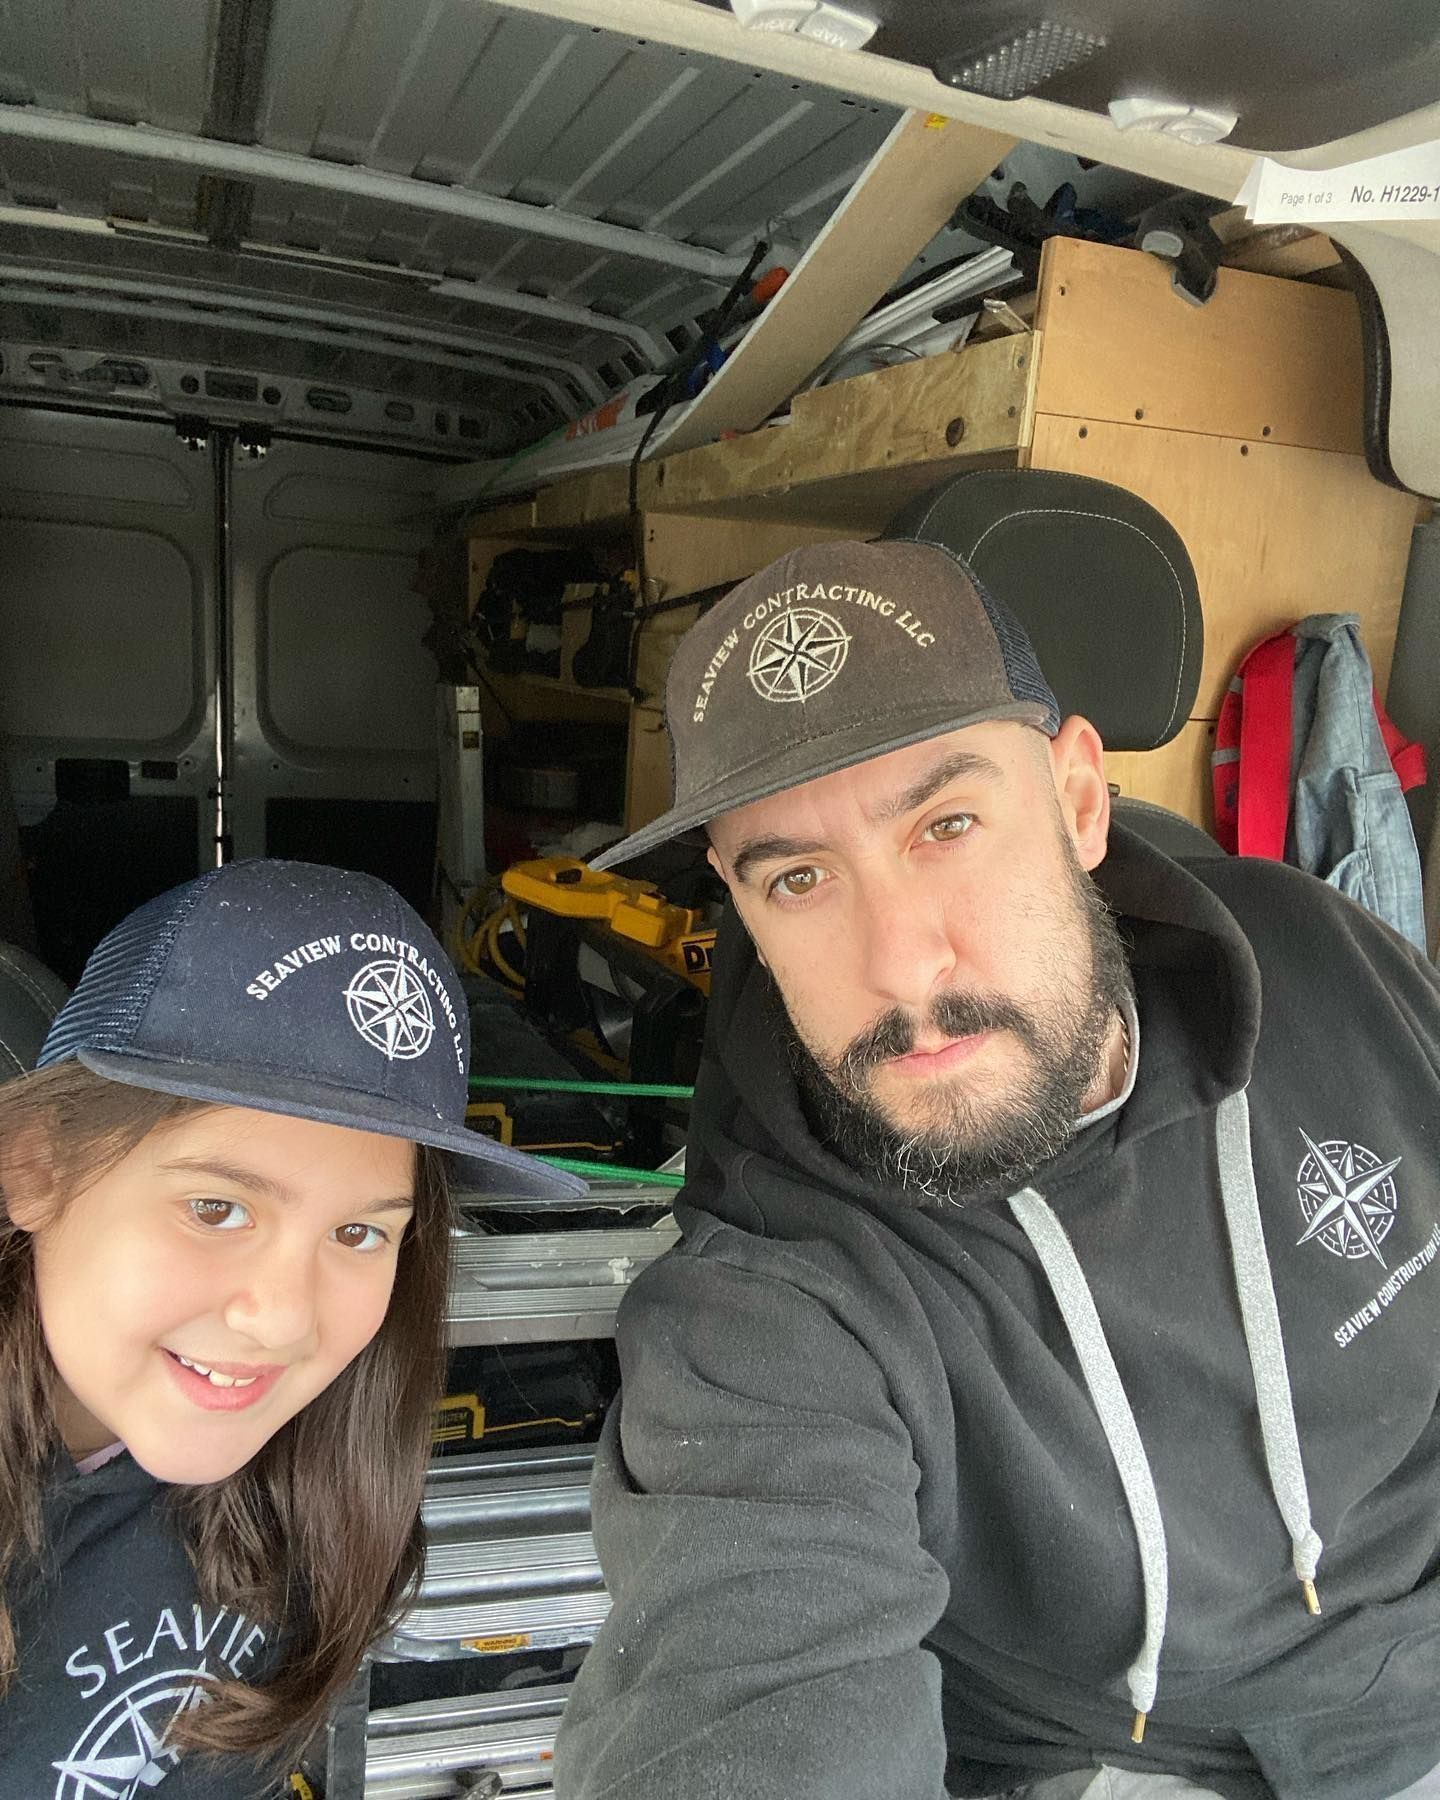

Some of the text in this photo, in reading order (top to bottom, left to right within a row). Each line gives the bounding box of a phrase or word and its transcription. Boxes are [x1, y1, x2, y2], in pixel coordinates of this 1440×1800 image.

[1281, 193, 1305, 207] Page
[1313, 193, 1324, 204] of
[1325, 193, 1333, 204] 3
[1350, 185, 1440, 203] No. H1229-1
[693, 582, 936, 723] SEAVIEW CONTRACTING LLC
[246, 934, 342, 1001] SEAVIEW
[350, 932, 457, 1030] CONTRACTING
[1333, 1298, 1382, 1349] SEAVIEW
[1377, 1238, 1438, 1308] CONSTRUCTION
[65, 1604, 266, 1699] SEAVIE
